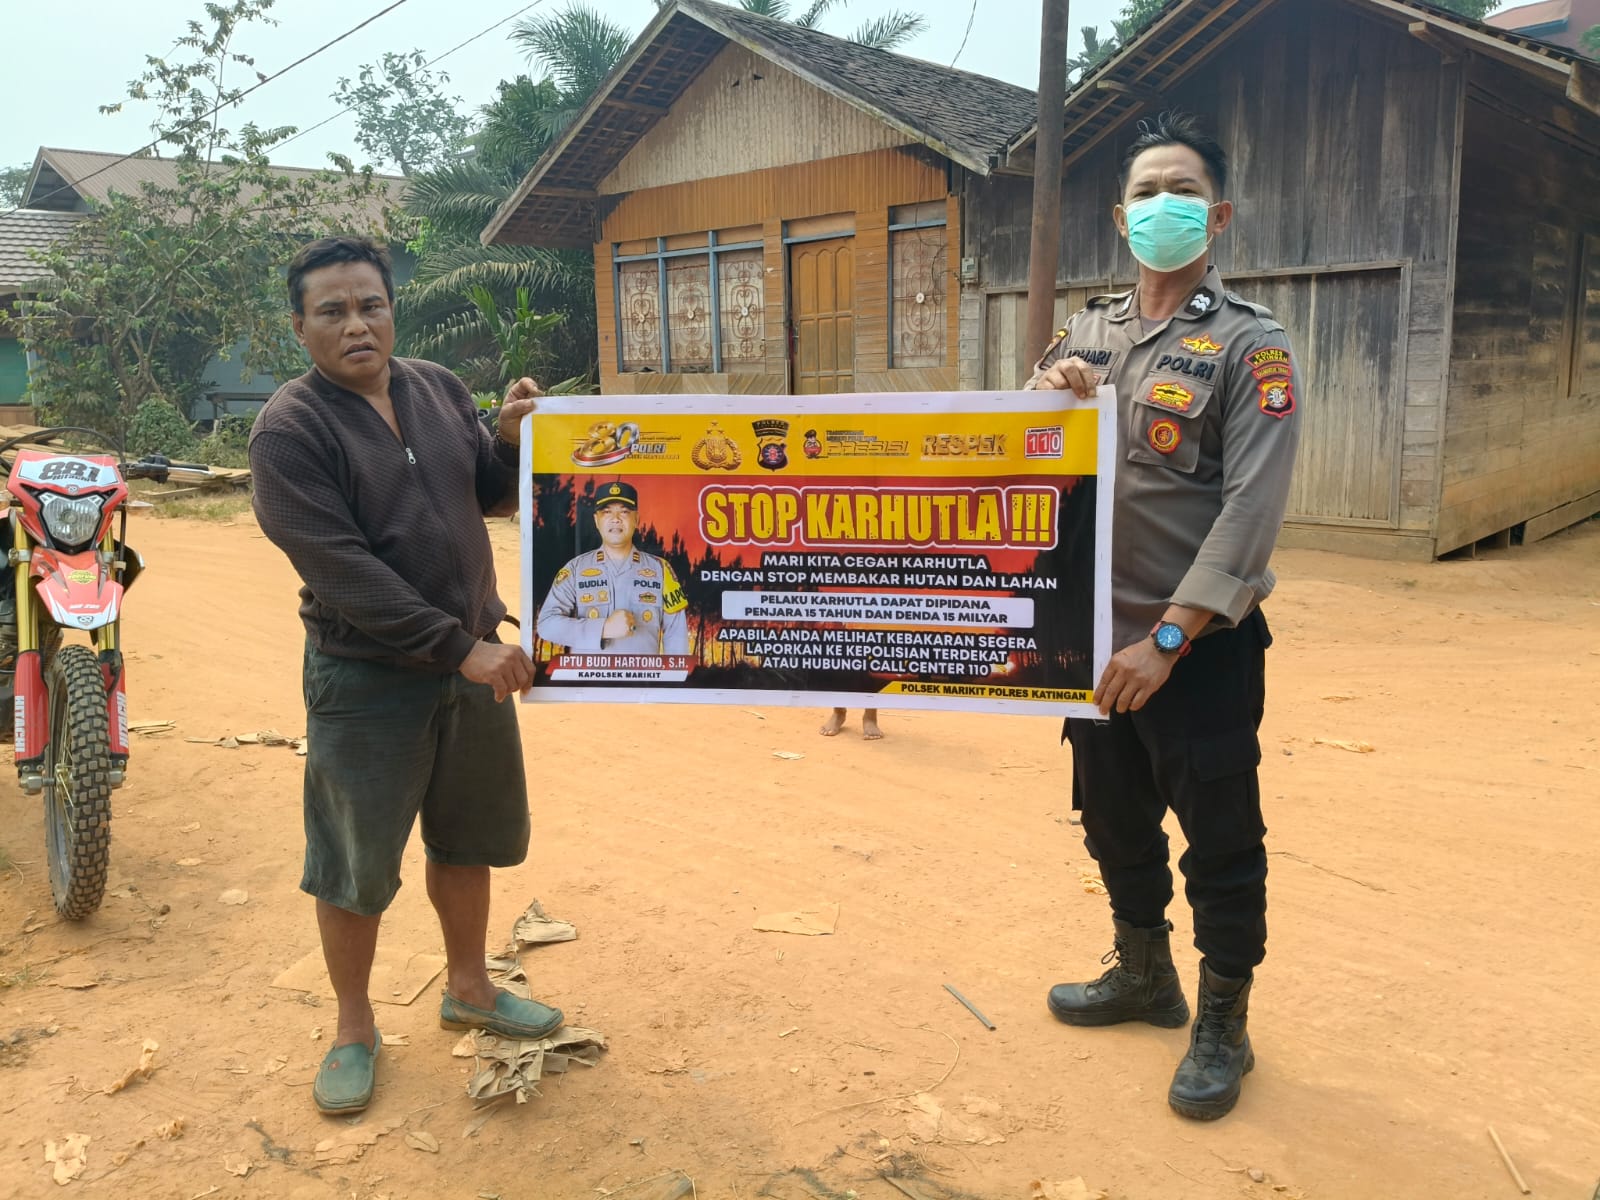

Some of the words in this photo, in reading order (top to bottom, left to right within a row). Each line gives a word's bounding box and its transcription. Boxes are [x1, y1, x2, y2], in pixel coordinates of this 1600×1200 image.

[1254, 349, 1283, 359] POLRES
[1156, 354, 1216, 380] POLRI
[630, 443, 668, 454] POLRI
[922, 434, 1007, 456] RESPEK
[1027, 432, 1061, 454] 110
[39, 461, 100, 482] 881
[705, 491, 798, 539] STOP
[806, 493, 1002, 541] KARHUTLA
[1011, 493, 1051, 542] !!!
[763, 554, 803, 567] MARI
[807, 555, 841, 567] KITA
[844, 556, 898, 568] CEGAH
[902, 557, 988, 570] KARHUTLA
[633, 579, 661, 590] POLRI
[701, 570, 764, 583] DENGAN
[767, 571, 807, 583] STOP
[810, 572, 900, 585] MEMBAKAR
[904, 574, 958, 587] HUTAN
[962, 575, 997, 588] DAN
[1001, 576, 1057, 590] LAHAN
[760, 594, 808, 605] PELAKU
[811, 596, 878, 606] KARHUTLA
[881, 597, 923, 608] DAPAT
[925, 598, 991, 610] DIPIDANA
[744, 607, 803, 617] PENJARA
[805, 608, 817, 617] 15
[819, 608, 862, 619] TAHUN
[865, 610, 893, 620] DAN
[896, 611, 940, 621] DENDA
[942, 612, 955, 622] 15
[958, 613, 1008, 623] MILYAR
[718, 628, 777, 641] APABILA
[780, 630, 820, 642] ANDA
[823, 631, 884, 644] MELIHAT
[887, 633, 975, 647] KEBAKARAN
[978, 636, 1037, 650] SEGERA
[559, 655, 583, 667] IPTU
[586, 656, 611, 667] BUDI
[614, 656, 666, 669] HARTONO,
[668, 658, 689, 668] S.H.
[746, 643, 822, 656] LAPORKAN
[826, 644, 843, 656] KE
[846, 645, 930, 659] KEPOLISIAN
[933, 648, 1008, 663] TERDEKAT
[578, 671, 623, 679] KAPOLSEK
[625, 671, 662, 679] MARIKIT
[762, 657, 799, 669] ATAU
[802, 658, 867, 671] HUBUNGI
[870, 659, 906, 673] CALL
[908, 662, 965, 675] CENTER
[969, 664, 989, 676] 110
[901, 683, 940, 694] POLSEK
[943, 685, 986, 696] MARIKIT
[988, 687, 1029, 698] POLRES
[1031, 689, 1087, 701] KATINGAN
[14, 695, 25, 752] HITACHI
